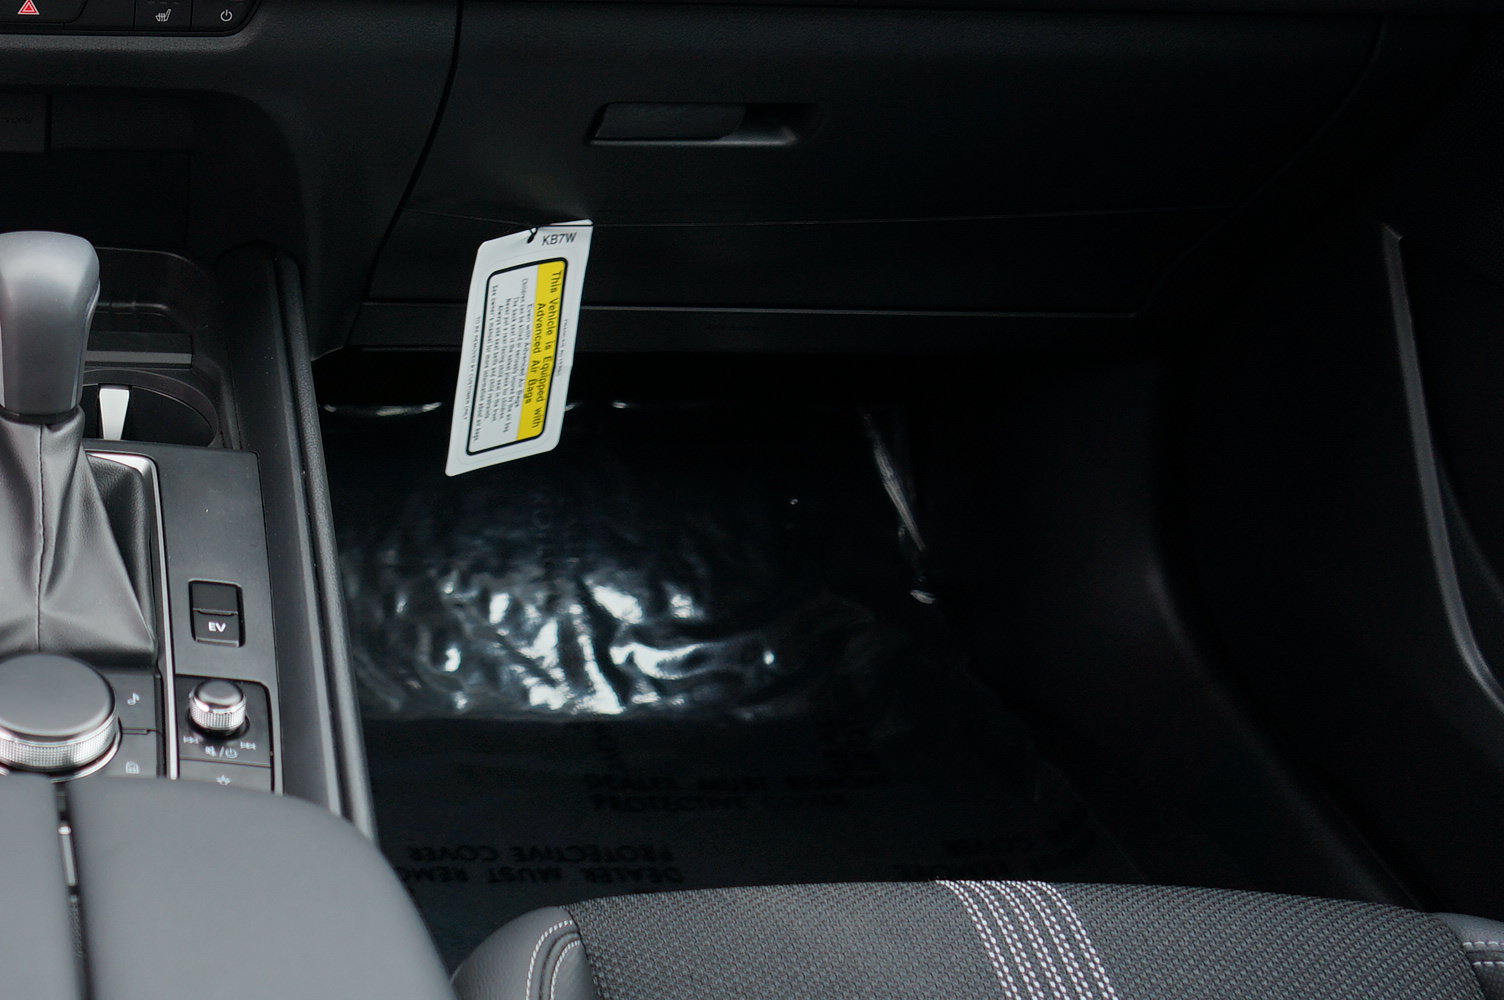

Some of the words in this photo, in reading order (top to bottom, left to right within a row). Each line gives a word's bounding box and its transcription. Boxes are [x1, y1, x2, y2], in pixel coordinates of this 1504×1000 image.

[541, 232, 577, 246] KB7W
[550, 270, 561, 292] This
[532, 301, 547, 354] Advanced
[545, 297, 558, 336] Vehicle
[545, 340, 552, 350] is
[531, 359, 540, 373] Air
[535, 355, 552, 403] Equipped
[524, 378, 537, 405] Bags
[532, 406, 542, 428] with
[208, 622, 226, 632] EV
